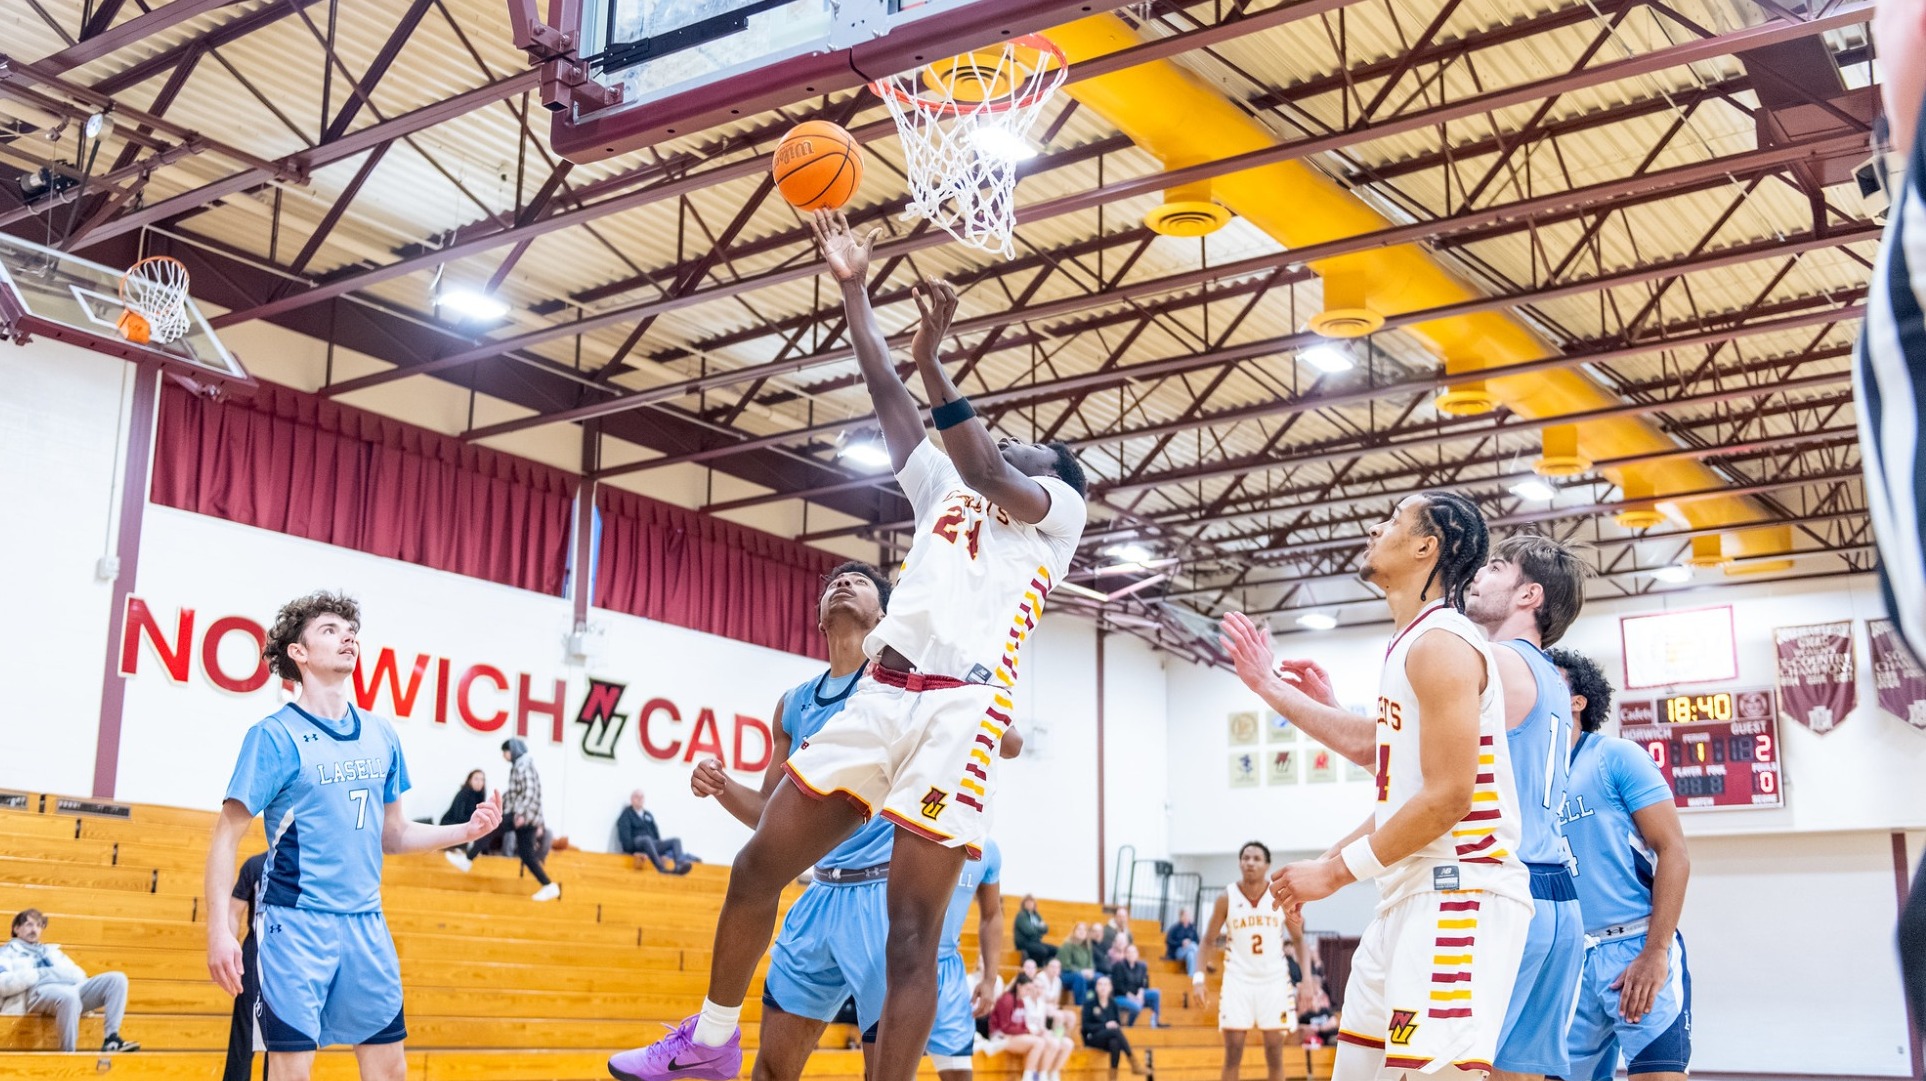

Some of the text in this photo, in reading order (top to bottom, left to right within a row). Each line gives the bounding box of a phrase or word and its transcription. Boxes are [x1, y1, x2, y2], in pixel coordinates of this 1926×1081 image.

[120, 596, 567, 743] NOWICH
[1667, 693, 1731, 723] 18:40
[1621, 727, 1672, 740] NORWICH
[1730, 720, 1767, 735] GUEST
[1648, 742, 1665, 768] 0
[1697, 742, 1704, 762] 1
[1755, 735, 1771, 762] 2
[317, 758, 386, 785] LASELL
[1760, 772, 1774, 792] 0
[349, 788, 369, 830] 7
[921, 785, 948, 821] NU
[1233, 916, 1278, 929] CADETS
[1251, 934, 1263, 955] 2
[1388, 1009, 1419, 1045] NU
